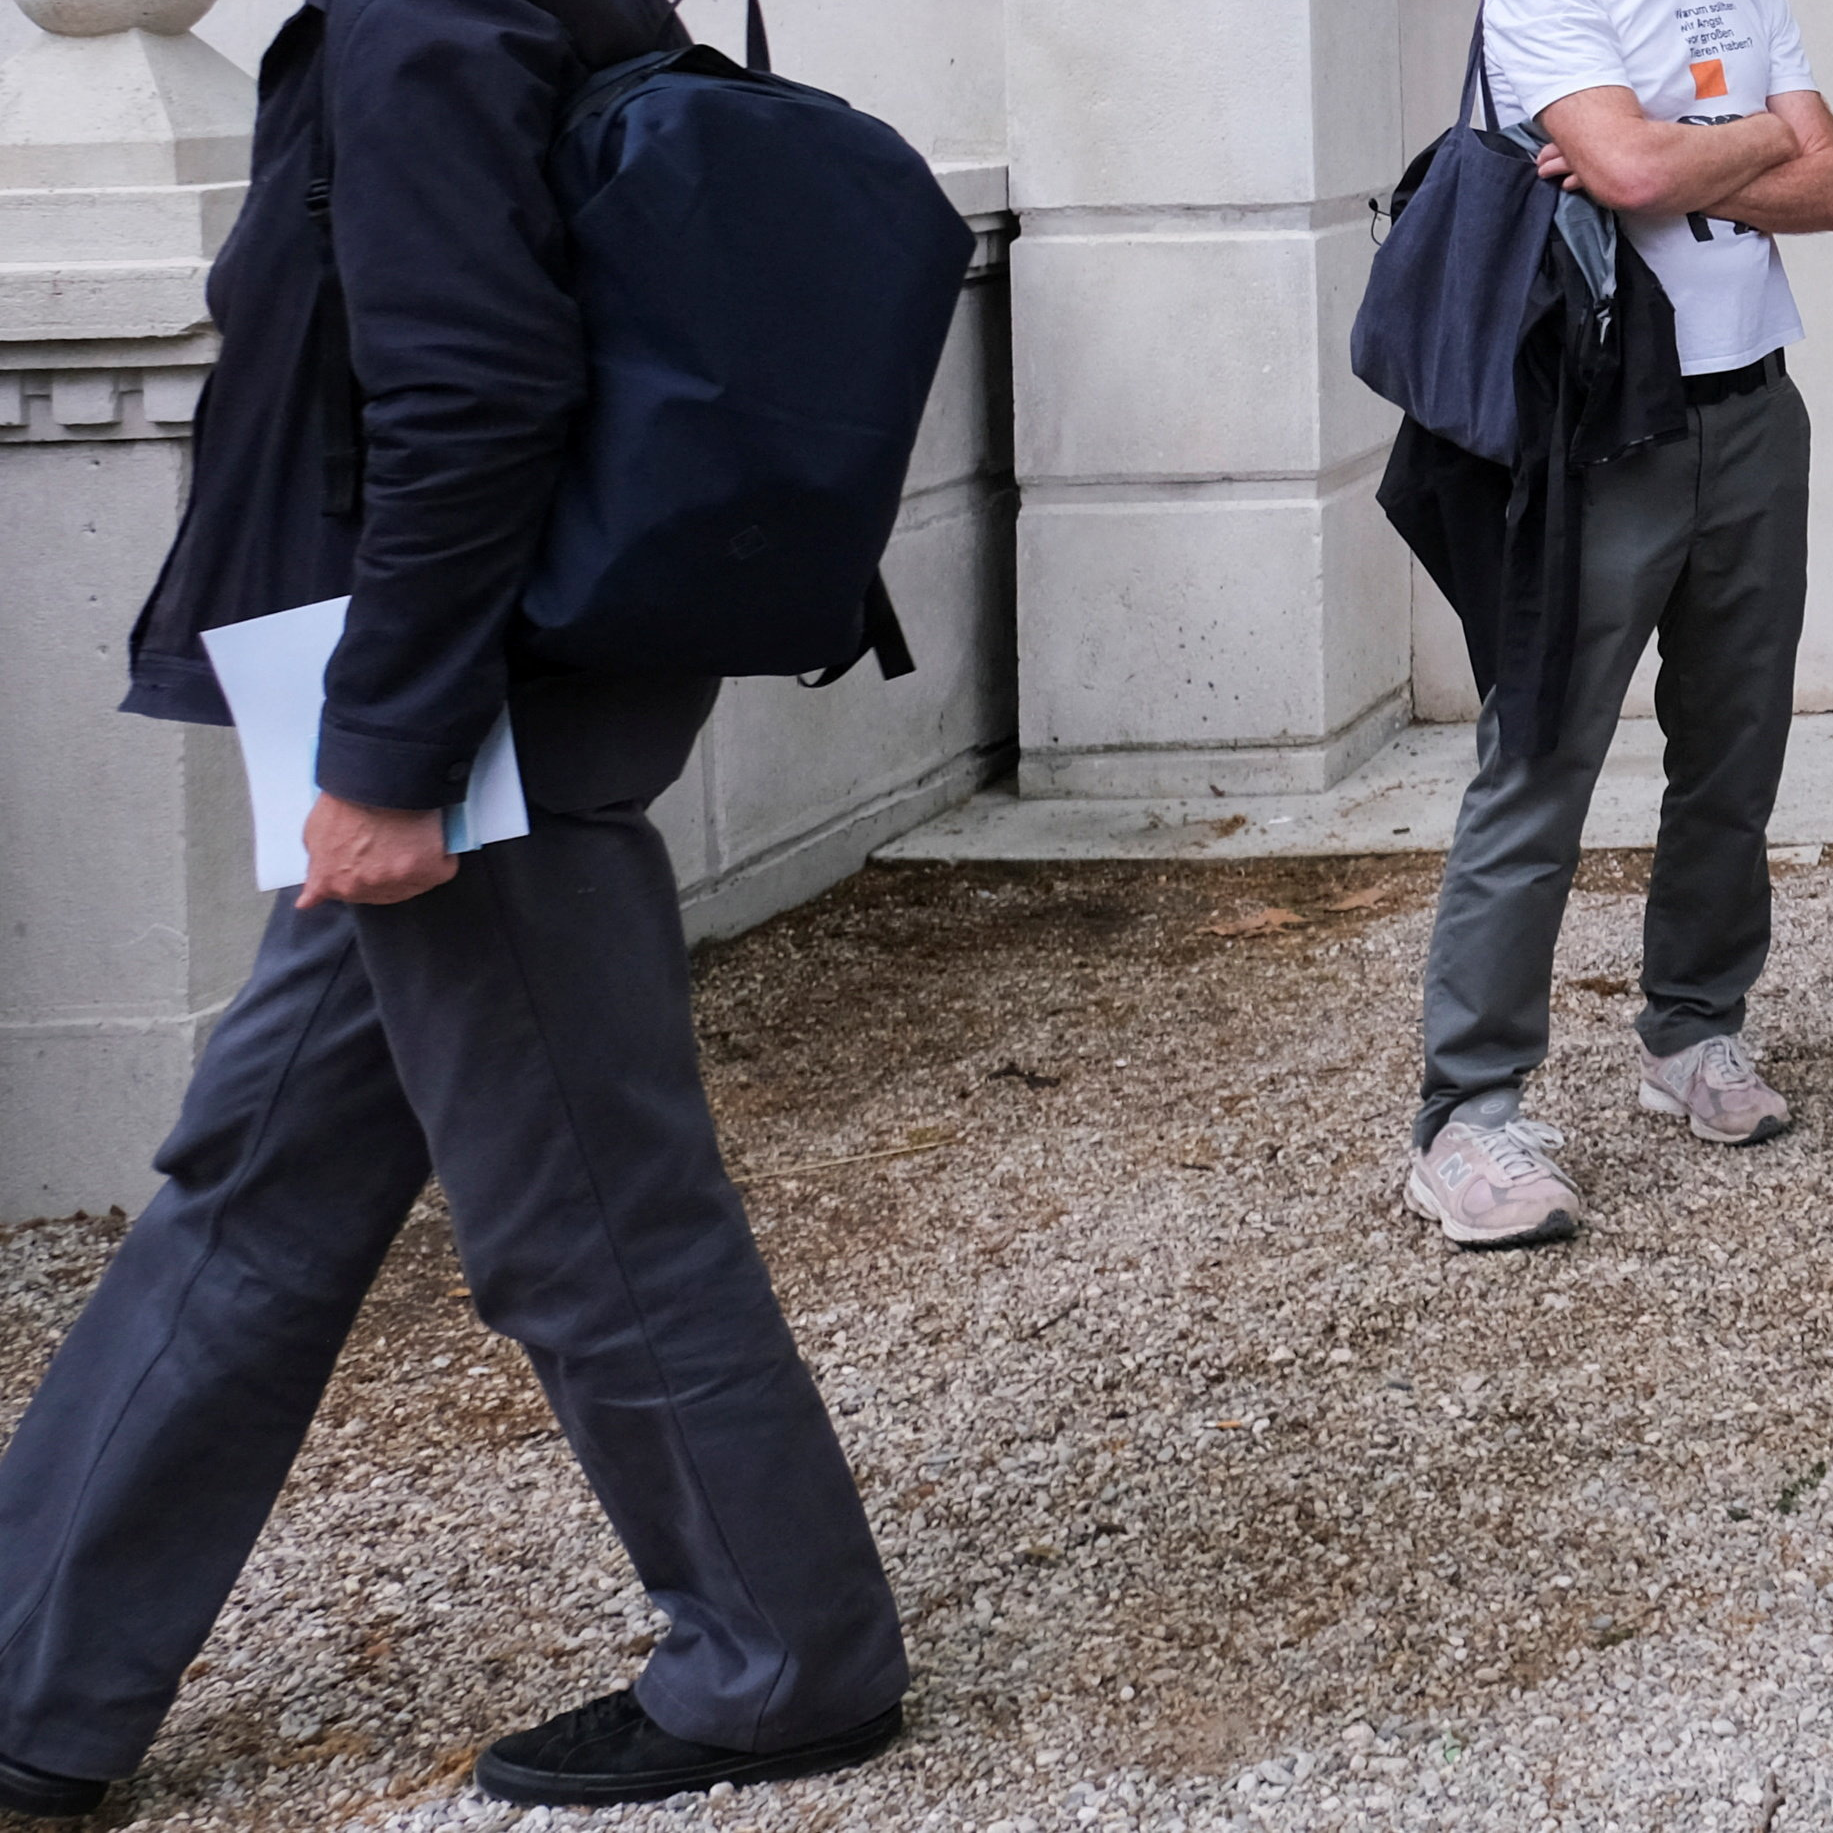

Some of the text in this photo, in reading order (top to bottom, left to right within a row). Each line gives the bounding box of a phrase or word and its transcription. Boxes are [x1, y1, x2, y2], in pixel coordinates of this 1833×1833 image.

[1697, 16, 1724, 28] Angst
[1685, 29, 1735, 44] vor großen
[1689, 37, 1753, 58] Tieren haben?
[1437, 1152, 1473, 1191] N
